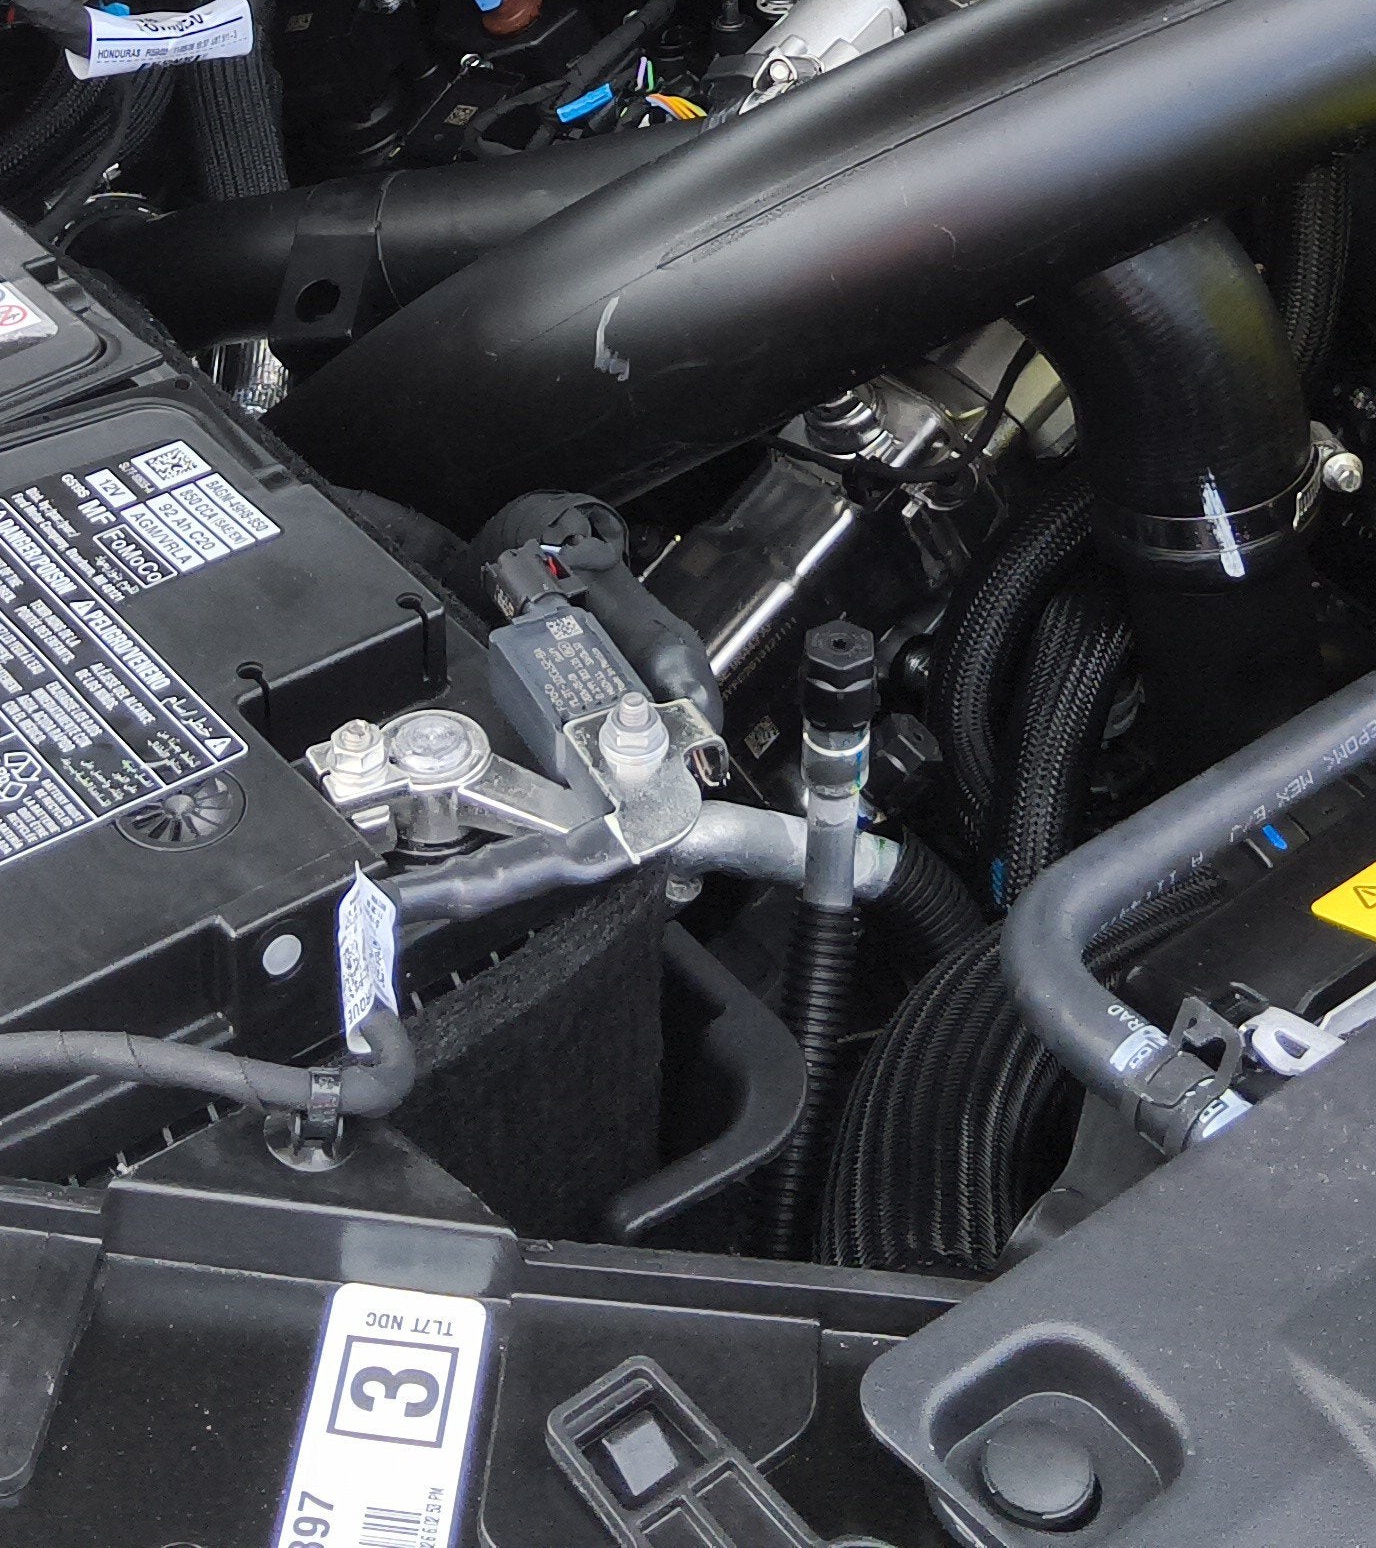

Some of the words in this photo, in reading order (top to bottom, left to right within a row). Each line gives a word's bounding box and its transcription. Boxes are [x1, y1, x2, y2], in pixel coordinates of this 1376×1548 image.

[96, 43, 141, 63] HONDURAS
[96, 477, 126, 499] 12V
[75, 498, 118, 528] MF
[177, 487, 204, 506] 850
[193, 502, 219, 520] CCA
[128, 508, 195, 566] AGM/VRLA
[156, 501, 179, 518] 92
[171, 515, 195, 532] Ah
[186, 528, 217, 551] C20
[100, 527, 168, 584] FoMoCo
[81, 608, 172, 691] PELIGRO/VENENO
[21, 795, 37, 807] LA
[364, 1311, 403, 1331] NDC
[410, 1316, 454, 1336] TL7T
[350, 1366, 439, 1418] 3
[427, 1486, 444, 1501] PM
